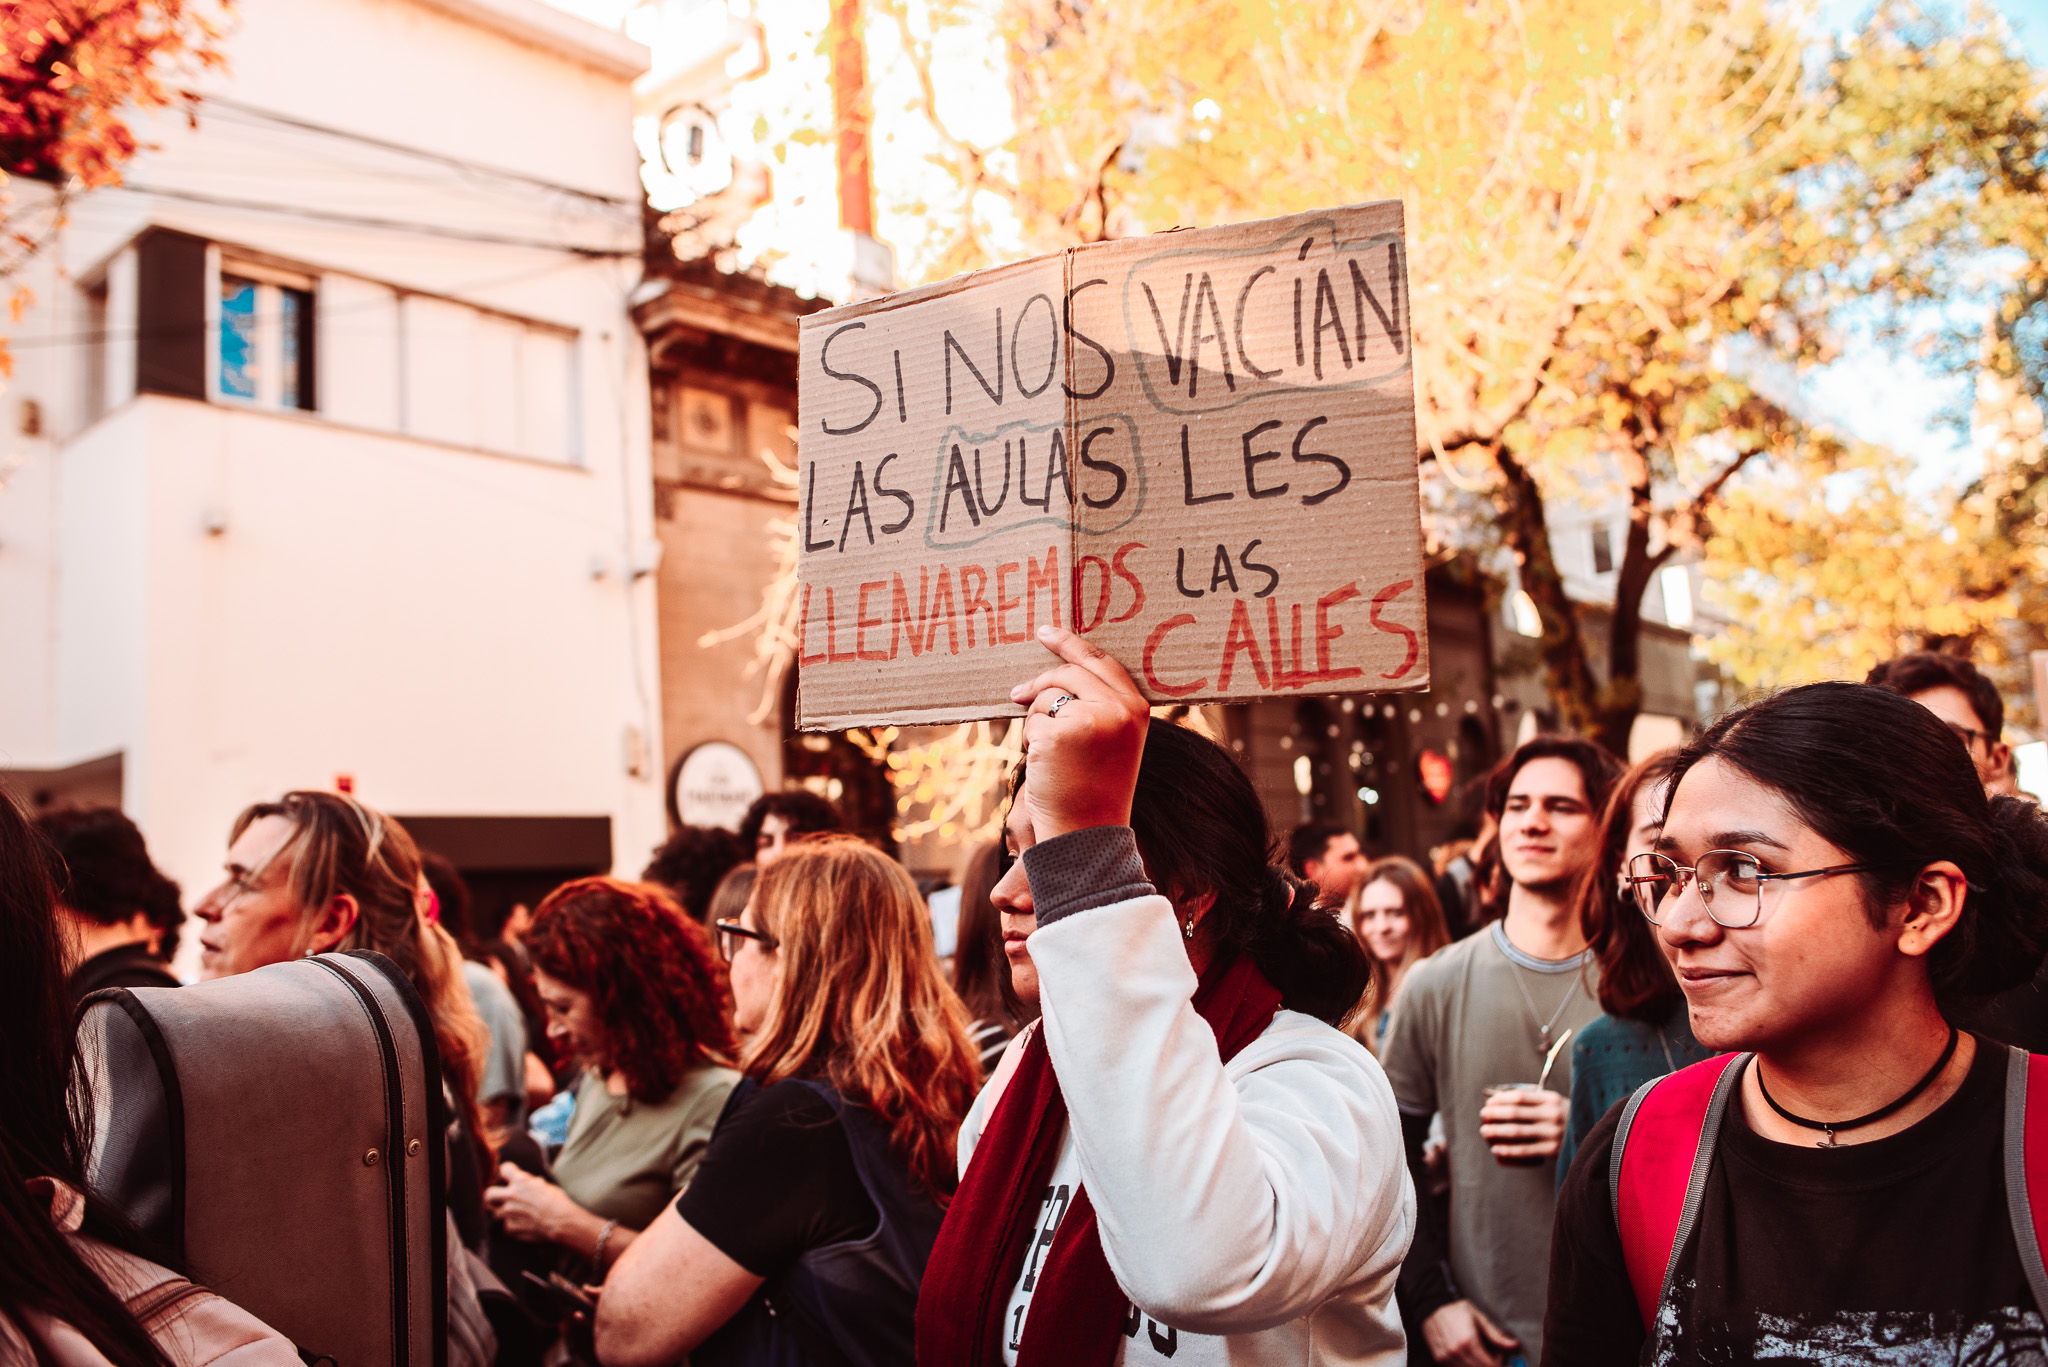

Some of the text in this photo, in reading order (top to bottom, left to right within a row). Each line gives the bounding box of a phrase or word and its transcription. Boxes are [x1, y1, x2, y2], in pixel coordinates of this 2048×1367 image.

[821, 237, 1403, 436] SI NOS VACÍAN
[805, 416, 1351, 553] LAS AULAS LES
[800, 539, 1279, 667] LLENAREMOS LAS
[1142, 579, 1418, 697] CALLES
